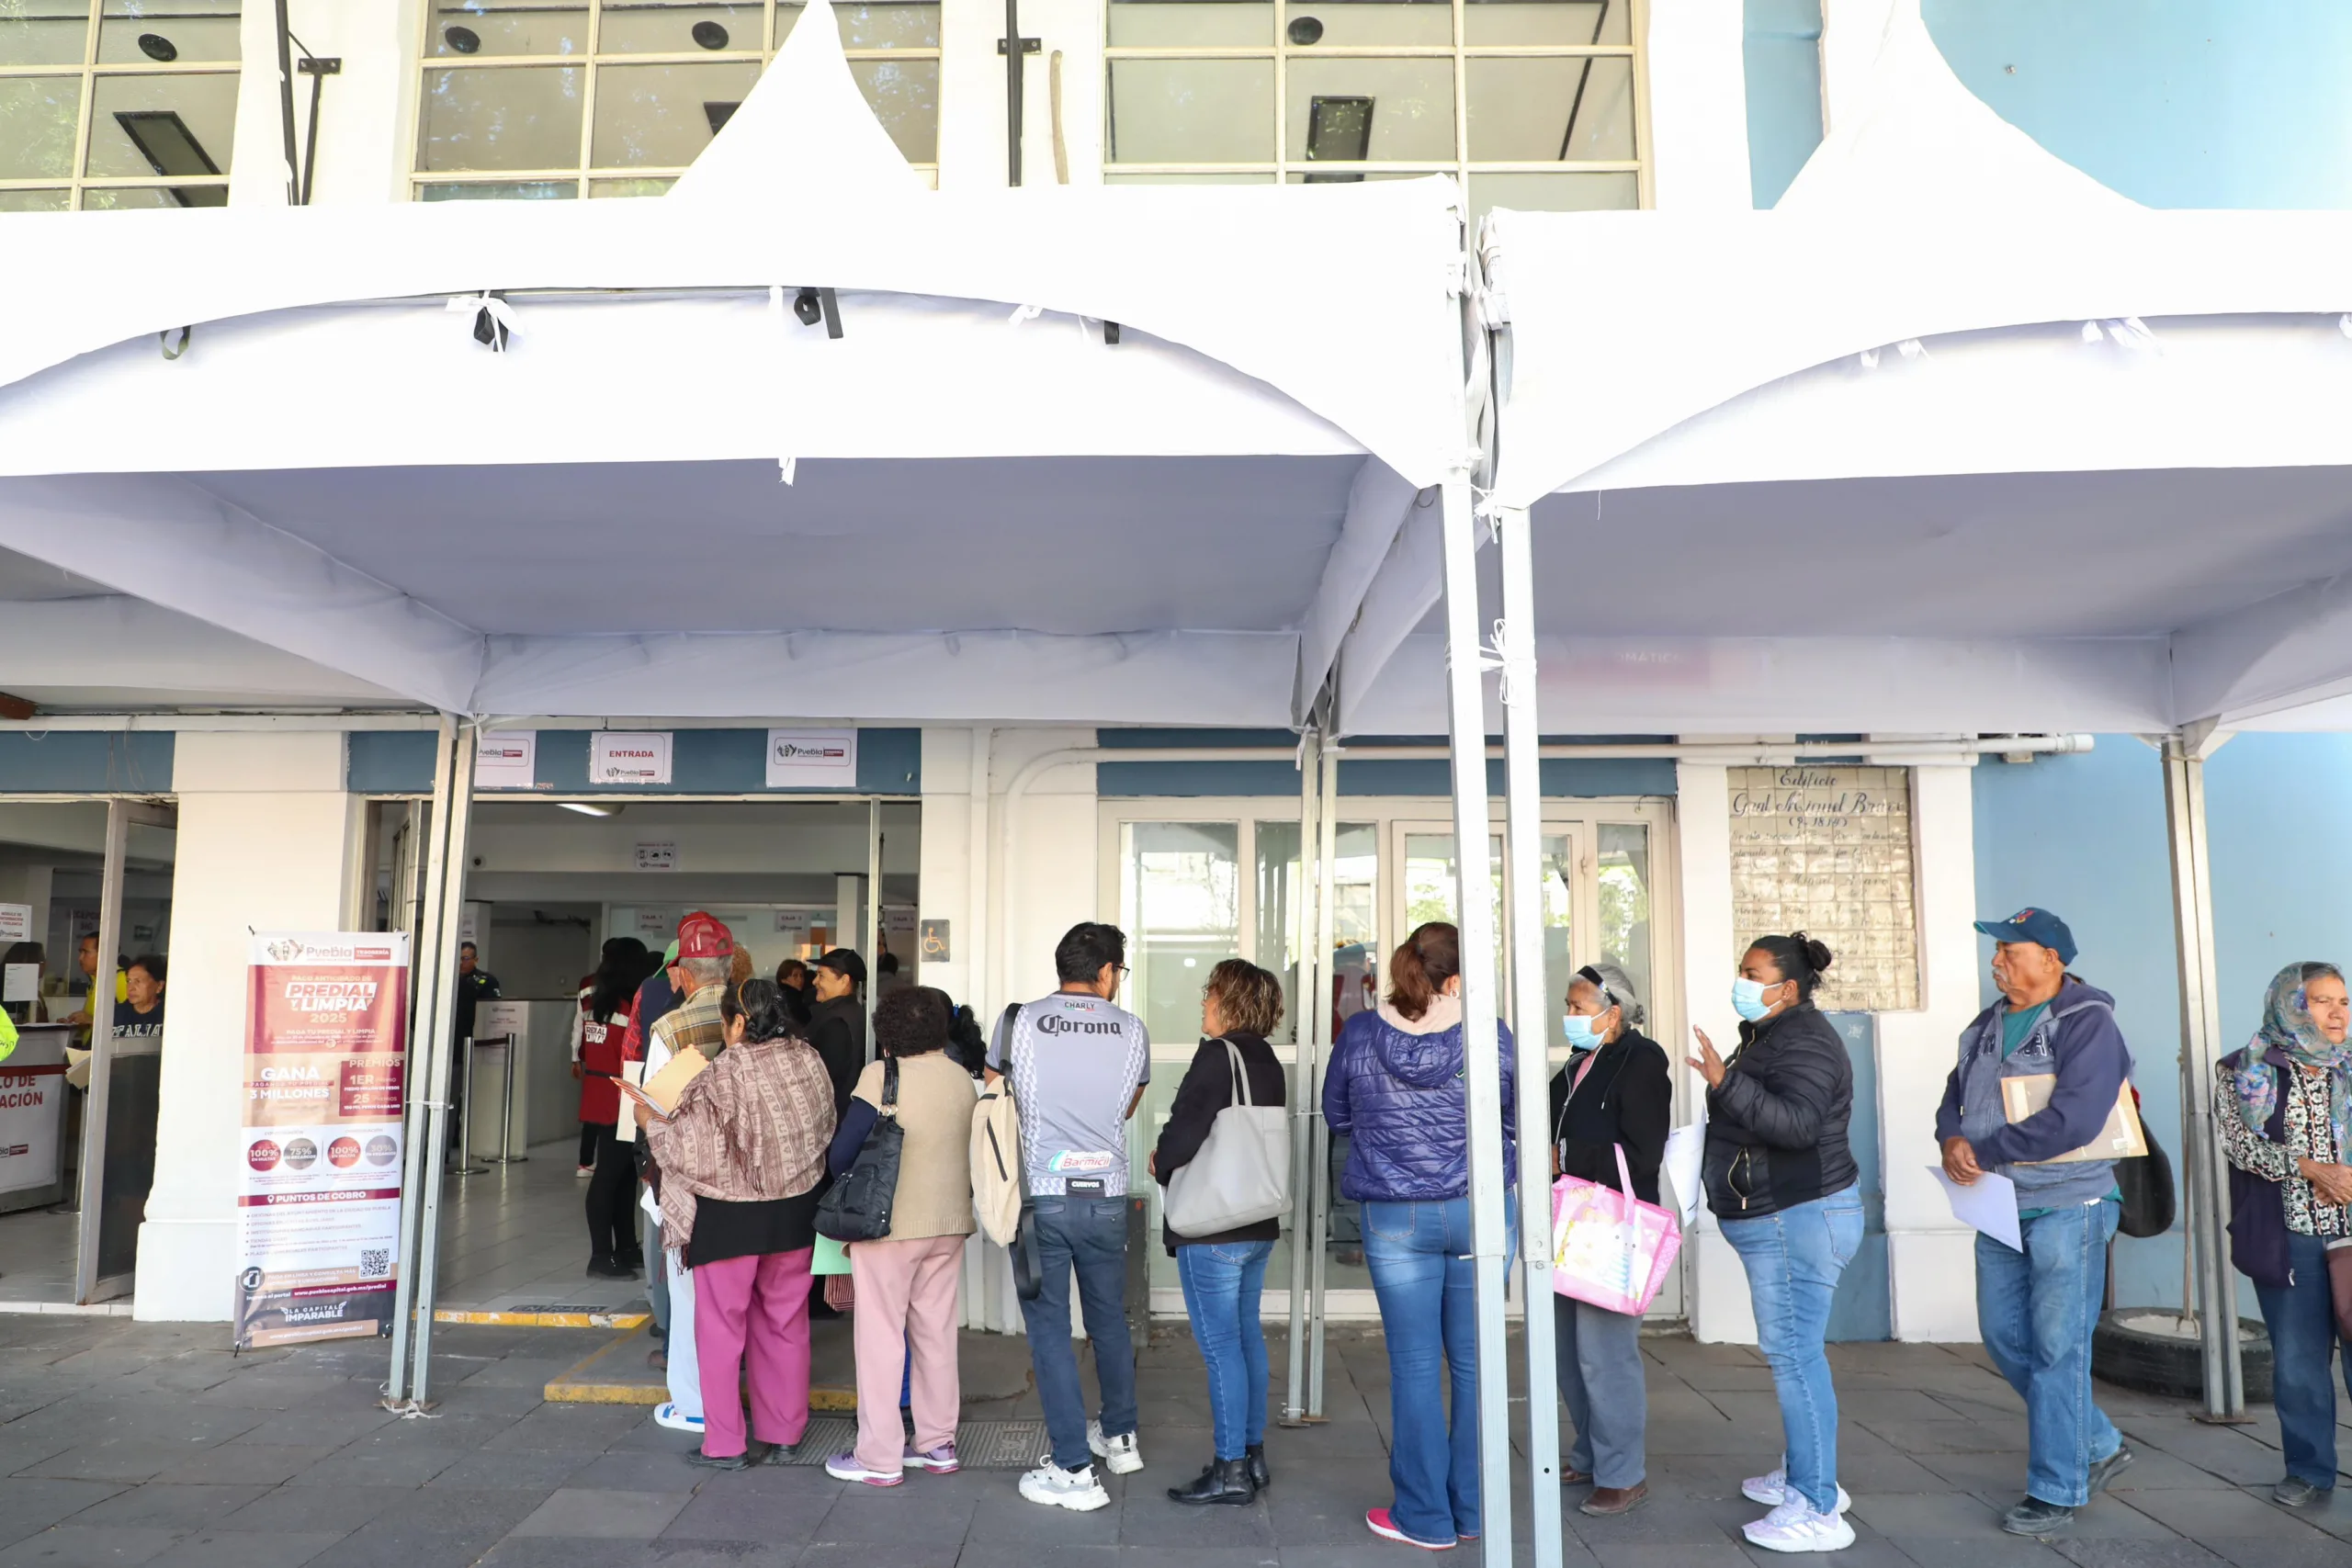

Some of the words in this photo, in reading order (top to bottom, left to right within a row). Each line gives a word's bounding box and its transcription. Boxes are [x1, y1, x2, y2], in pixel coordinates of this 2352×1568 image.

[797, 748, 823, 756] Puebla
[1775, 792, 1847, 813] Miguel
[306, 945, 352, 957] Puebla
[288, 984, 373, 998] PREDIAL
[290, 998, 300, 1008] Y
[300, 998, 369, 1011] LIMPIA
[1064, 1001, 1095, 1010] CHARLY
[310, 1013, 347, 1023] 2025
[1036, 1014, 1123, 1037] Corona
[349, 1058, 401, 1068] PREMIOS
[261, 1066, 321, 1081] GANA
[18, 1077, 36, 1088] DE
[349, 1075, 374, 1085] 1ER
[249, 1090, 258, 1100] 3
[260, 1089, 330, 1100] MILLONES
[354, 1094, 369, 1104] 25
[250, 1149, 278, 1157] 100%
[290, 1147, 311, 1156] 75%
[330, 1146, 359, 1155] 100%
[1062, 1156, 1111, 1168] Barmicil
[277, 1193, 315, 1203] PUNTOS
[317, 1192, 330, 1201] DE
[332, 1191, 366, 1200] COBRO
[286, 1309, 344, 1323] IMPARABLE
